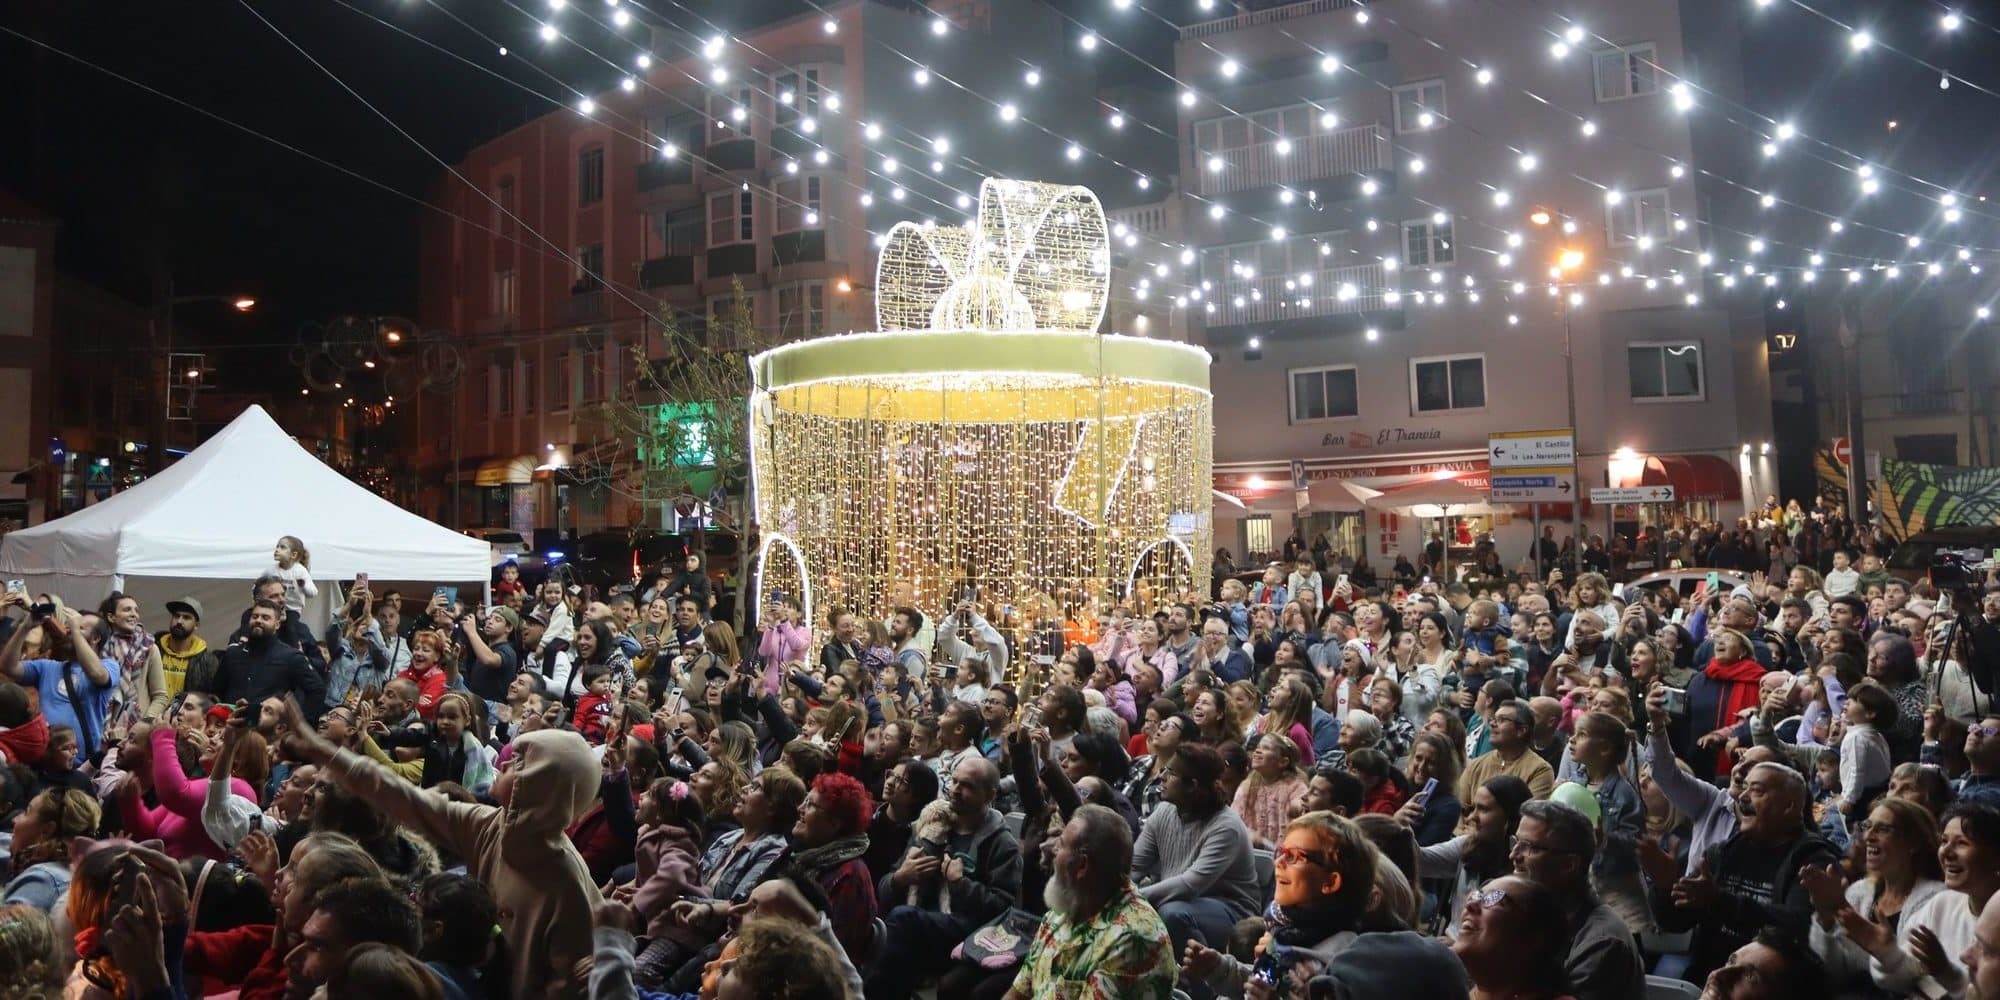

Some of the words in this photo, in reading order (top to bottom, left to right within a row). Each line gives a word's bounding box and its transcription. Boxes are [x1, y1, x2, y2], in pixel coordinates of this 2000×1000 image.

[1321, 433, 1345, 447] Bar
[1376, 429, 1391, 446] El
[1293, 462, 1304, 488] P
[1409, 464, 1425, 475] EL
